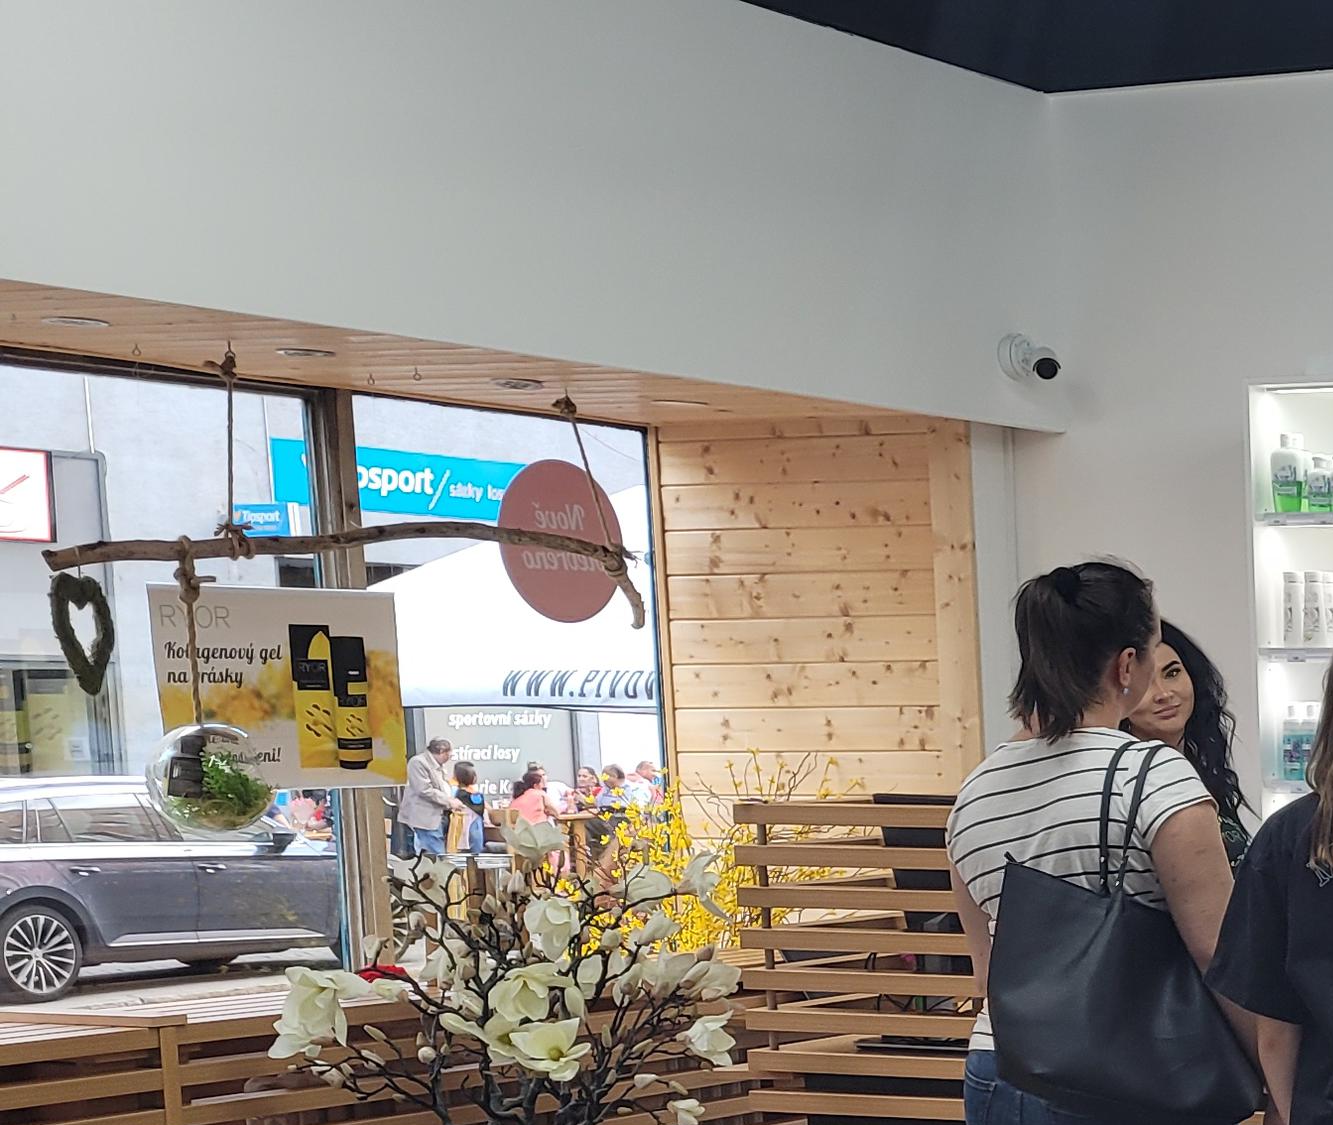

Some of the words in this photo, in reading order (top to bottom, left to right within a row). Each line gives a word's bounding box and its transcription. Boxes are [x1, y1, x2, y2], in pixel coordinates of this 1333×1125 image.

[258, 644, 284, 666] gel
[167, 670, 189, 684] na
[198, 665, 245, 689] rásky
[493, 744, 521, 763] losy
